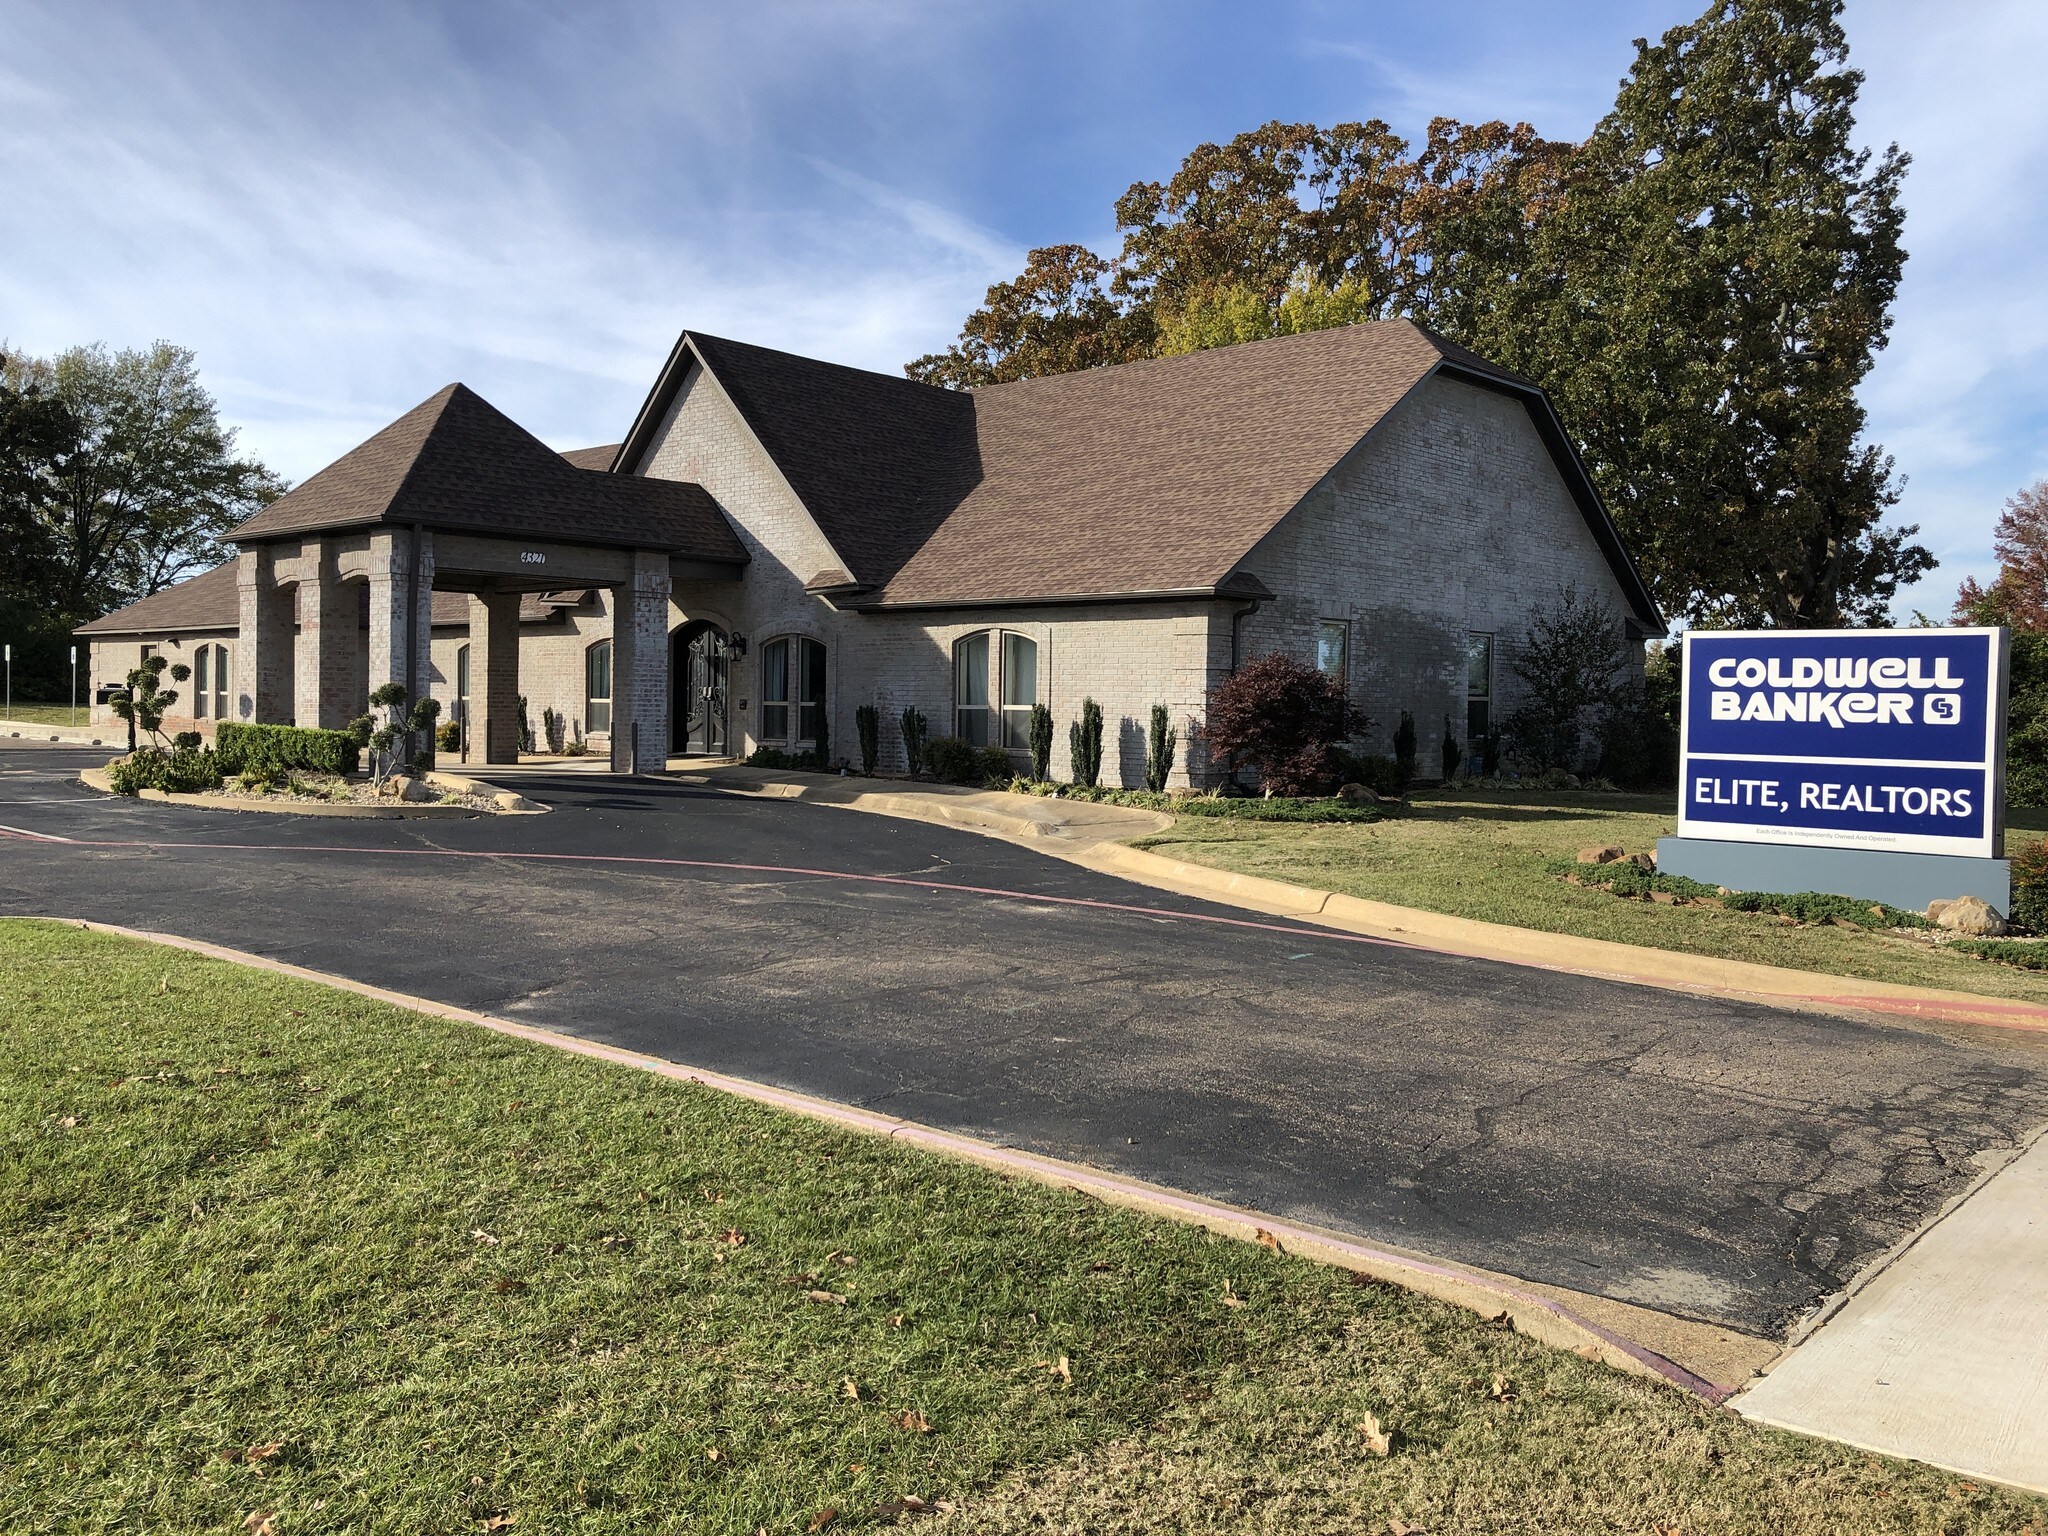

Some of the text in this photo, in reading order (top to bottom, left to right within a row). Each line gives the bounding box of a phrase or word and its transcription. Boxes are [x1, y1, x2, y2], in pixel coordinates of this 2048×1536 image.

[521, 551, 546, 564] 4321
[1708, 657, 1965, 689] COLDWELL
[1710, 690, 1914, 729] BANKER
[1695, 777, 1973, 818] ELITE, REALTORS
[1771, 828, 1788, 836] Office
[1794, 830, 1833, 840] Independently
